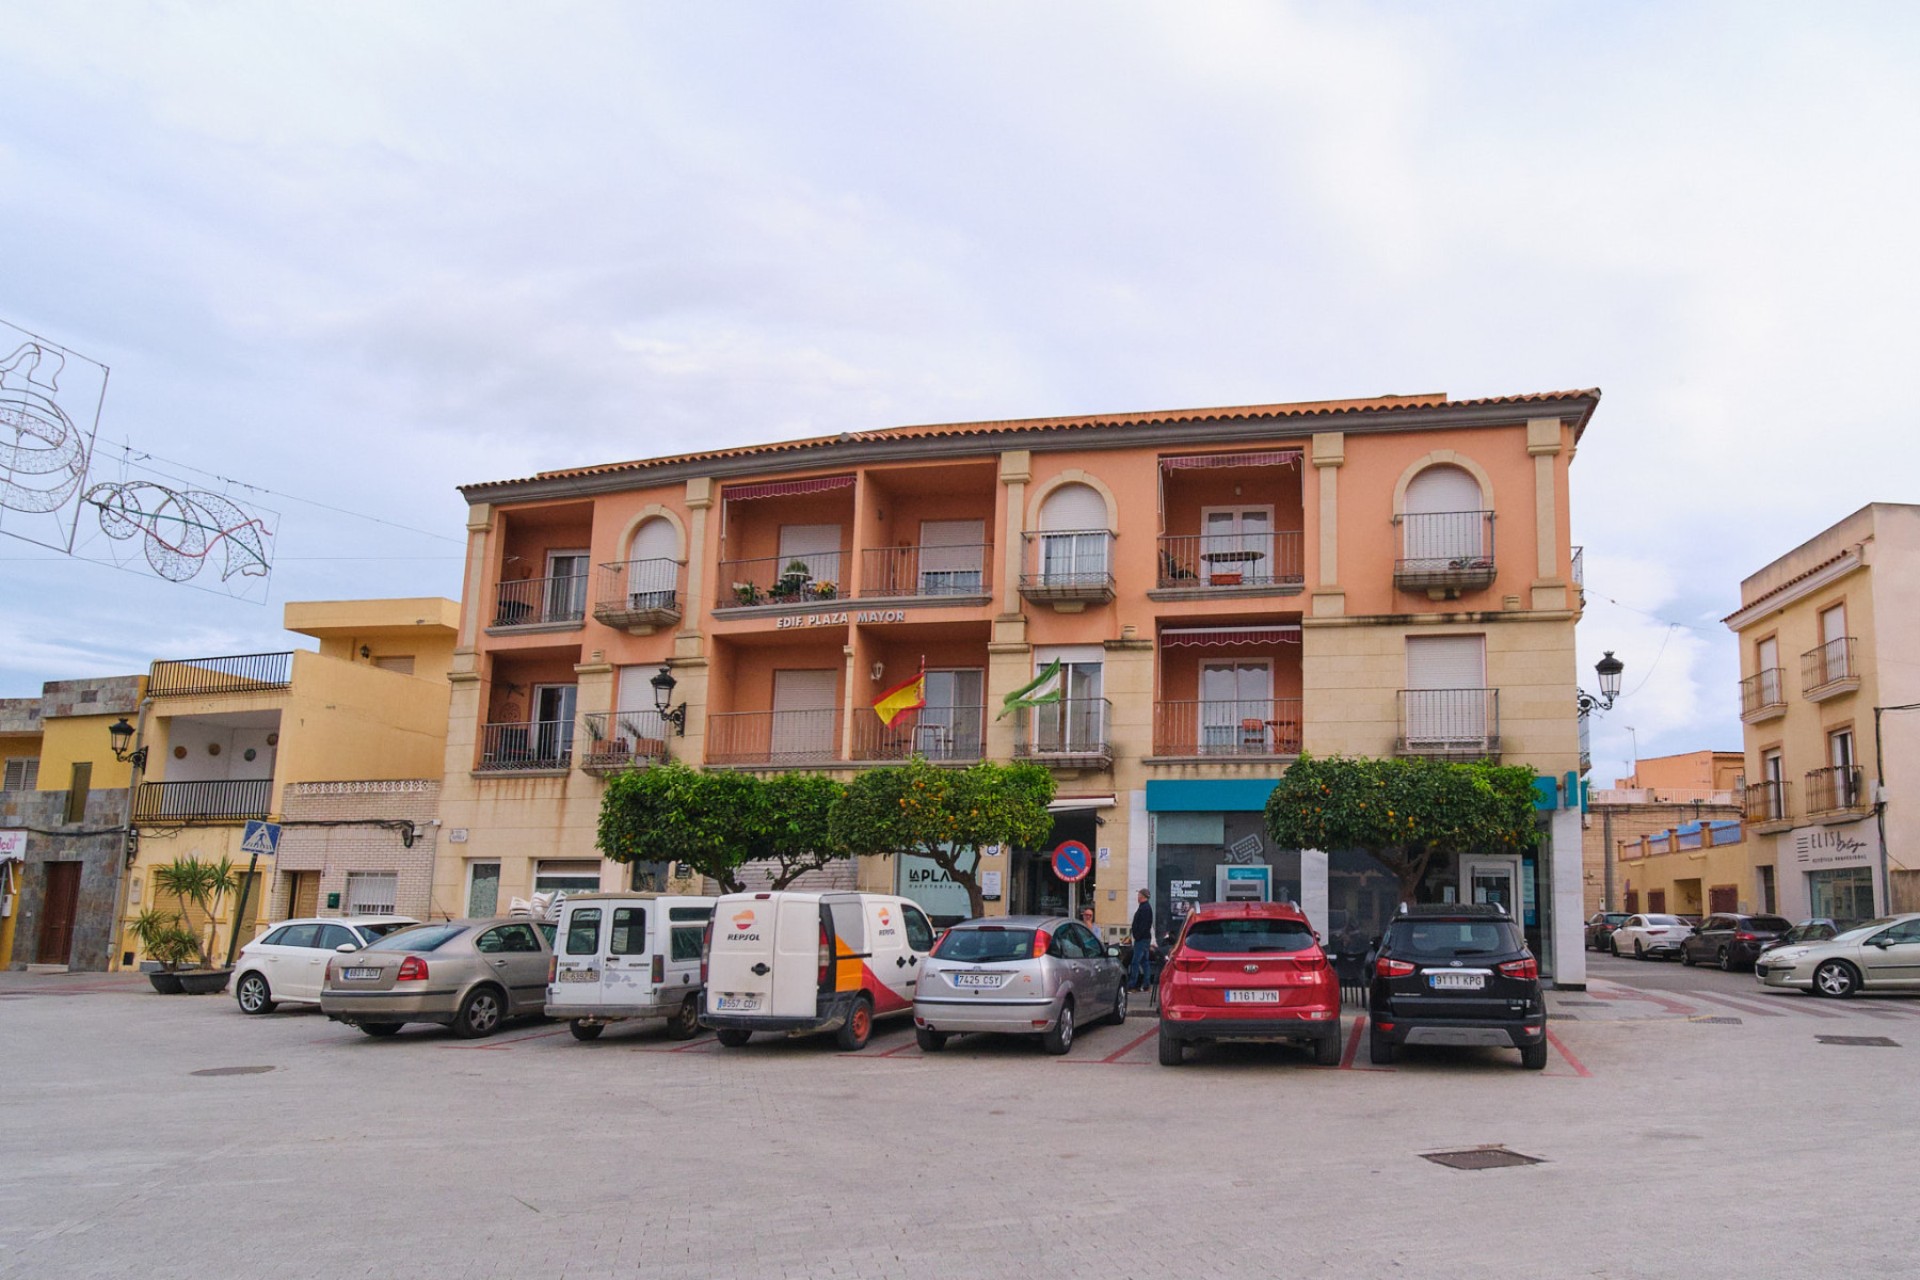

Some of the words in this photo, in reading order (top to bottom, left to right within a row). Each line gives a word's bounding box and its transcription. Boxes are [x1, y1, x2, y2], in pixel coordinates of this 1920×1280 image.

[777, 616, 803, 628] EDIF.
[808, 612, 849, 625] PLAZA
[857, 610, 905, 623] MAYOR
[909, 869, 919, 881] LA
[921, 868, 952, 882] PLA
[727, 933, 760, 941] REPSOL
[959, 975, 980, 985] 7425
[983, 975, 1000, 985] CSY
[1436, 975, 1460, 985] 9111
[1463, 976, 1482, 986] KPG
[1233, 990, 1255, 1001] 1161
[1259, 990, 1277, 1001] JYN
